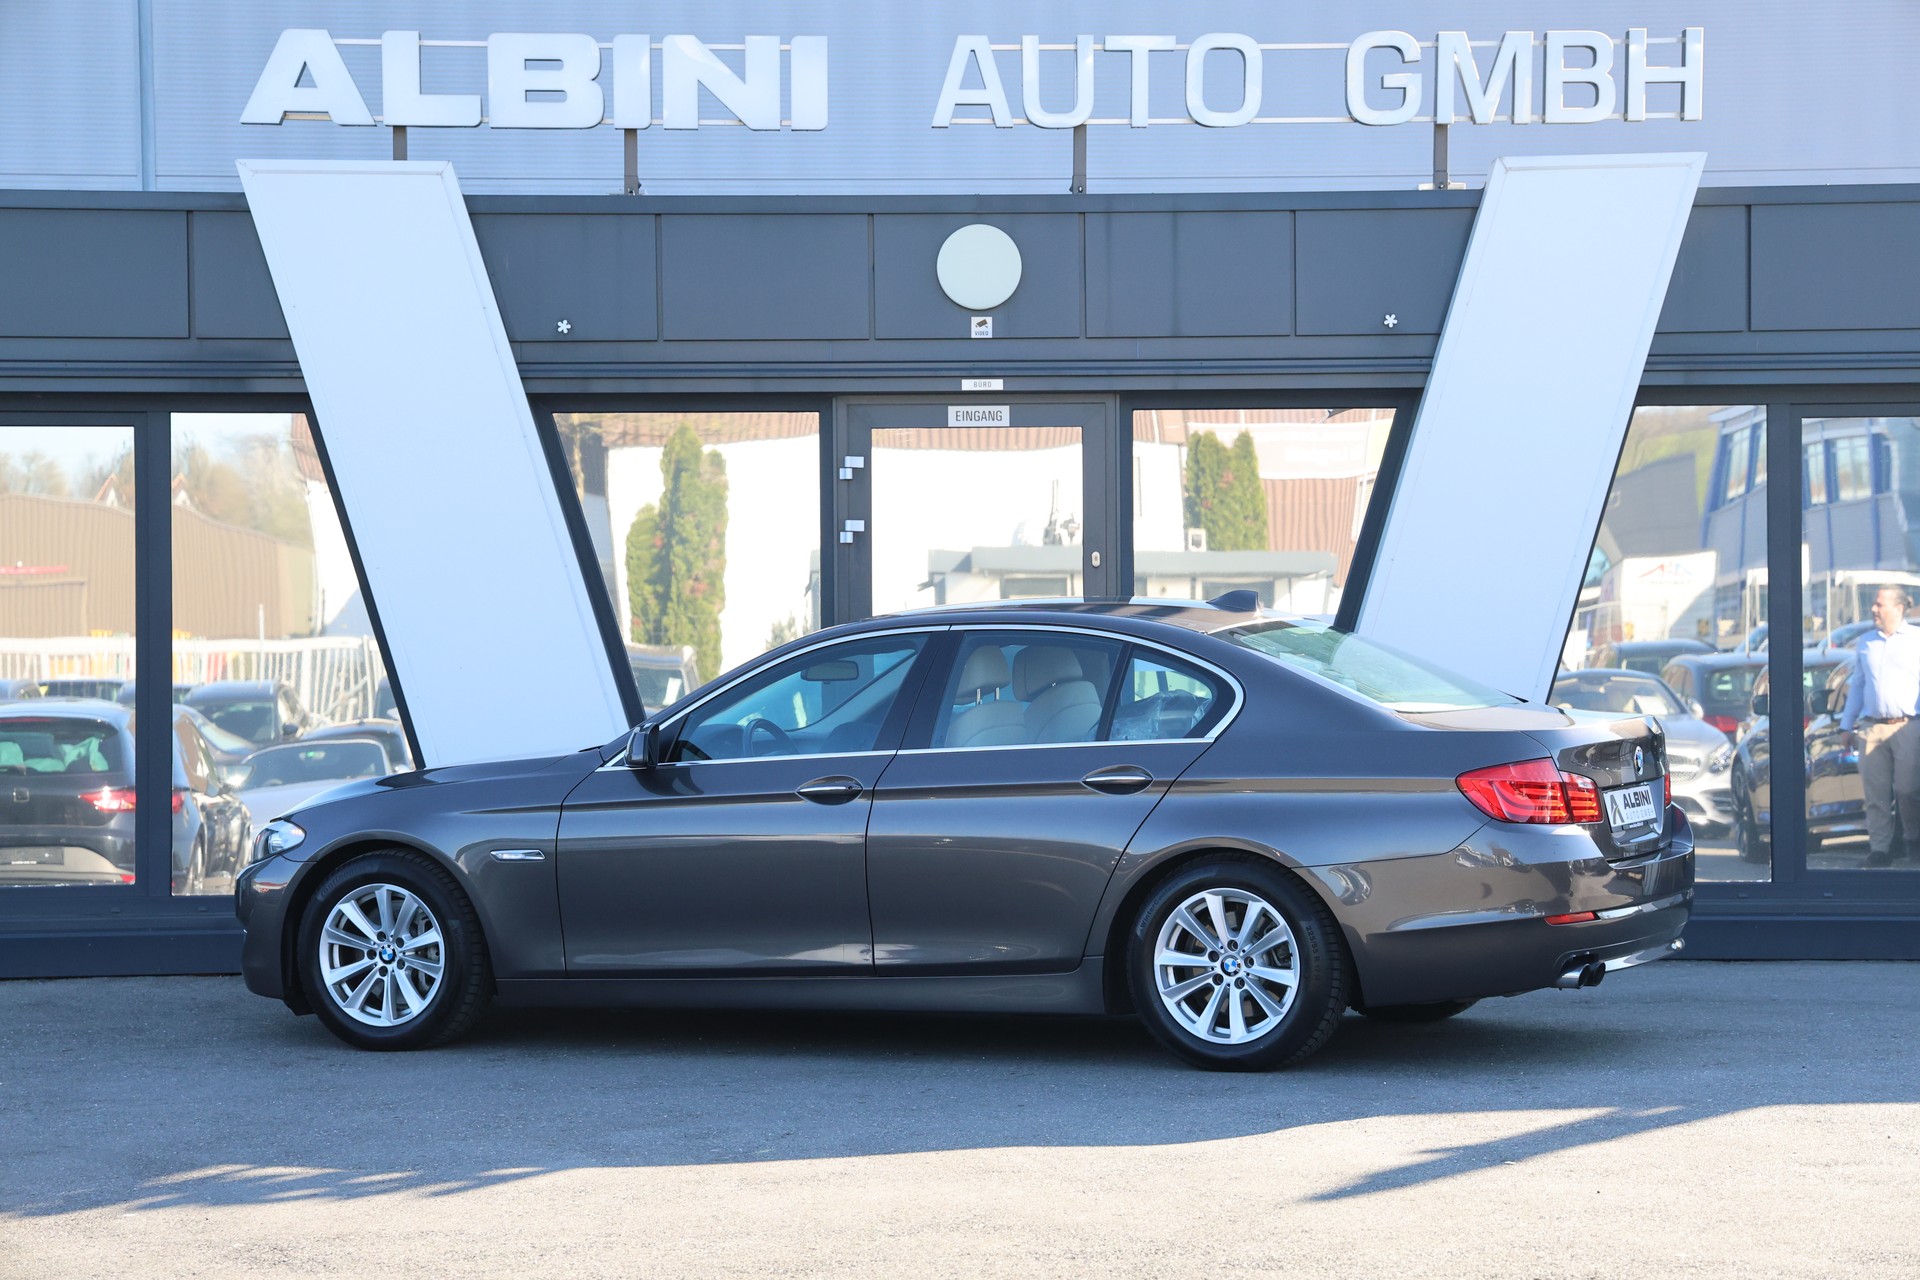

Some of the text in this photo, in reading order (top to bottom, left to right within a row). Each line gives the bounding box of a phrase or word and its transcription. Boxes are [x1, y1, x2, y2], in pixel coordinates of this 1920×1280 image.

[239, 27, 1704, 131] ALBINI AUTO GMBH
[955, 410, 1003, 422] EINGANG
[1622, 789, 1652, 810] ALBINI
